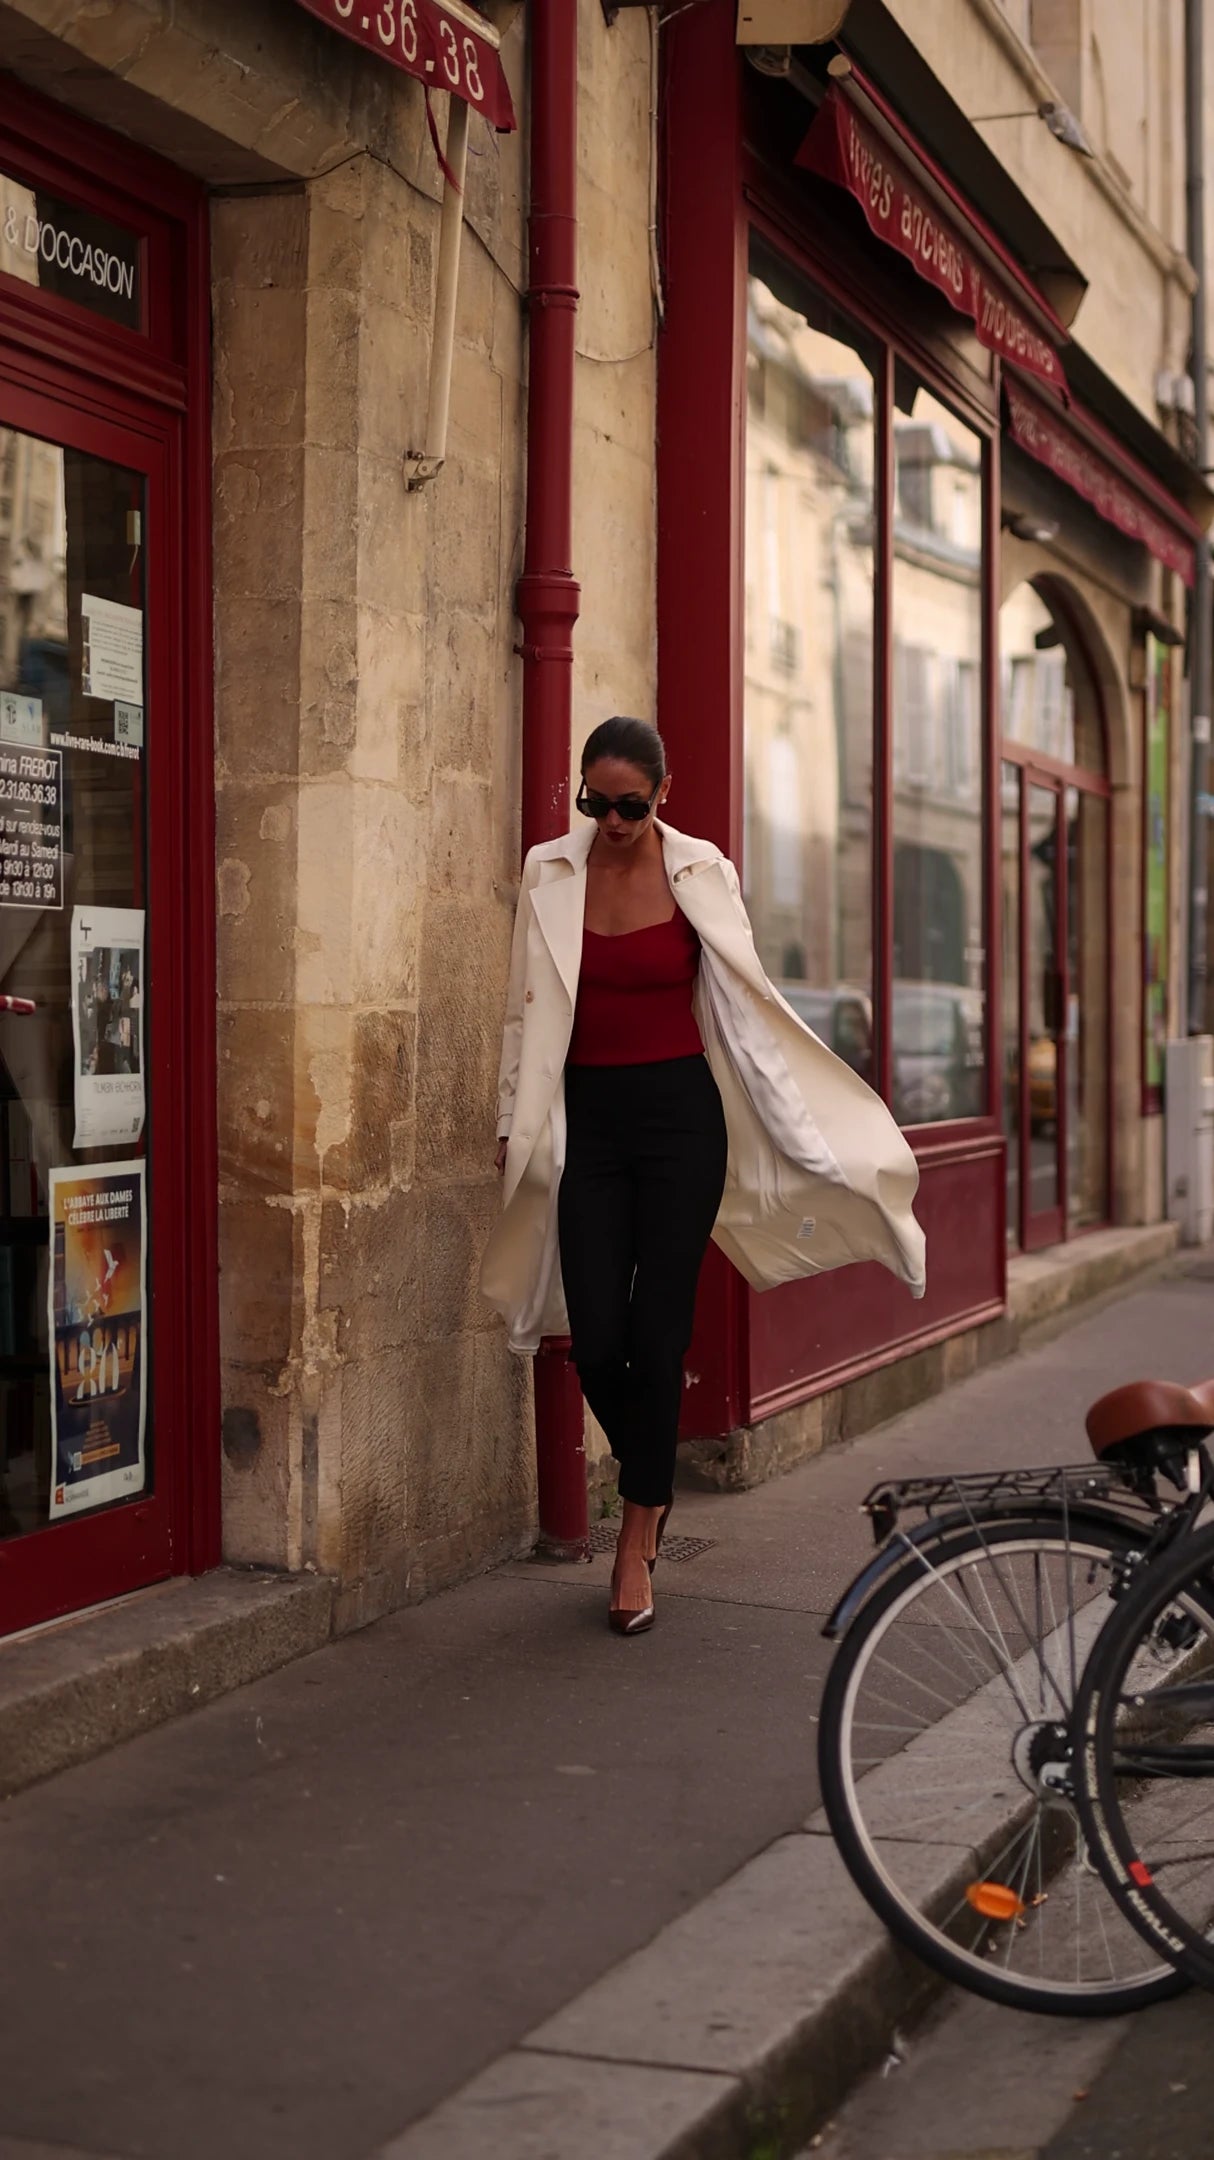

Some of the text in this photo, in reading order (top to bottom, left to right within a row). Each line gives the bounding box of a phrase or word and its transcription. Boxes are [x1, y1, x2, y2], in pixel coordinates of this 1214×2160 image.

[335, 0, 484, 101] .36.38
[5, 206, 134, 299] & D'OCCASION
[901, 194, 963, 293] anciens
[19, 755, 58, 780] FREROT
[6, 820, 17, 833] sur
[18, 819, 60, 837] rendez-vous
[20, 843, 30, 857] au
[31, 841, 59, 860] Samedi
[3, 859, 24, 876] 9h30
[24, 860, 30, 877] à
[32, 862, 55, 880] 12h30
[12, 880, 35, 898] 13h30
[35, 881, 41, 899] à
[43, 882, 56, 900] 19h
[64, 1189, 133, 1210] L'ABBAYE AUX DAMES
[95, 1209, 104, 1222] LA
[105, 1203, 129, 1220] LIBERTÉ
